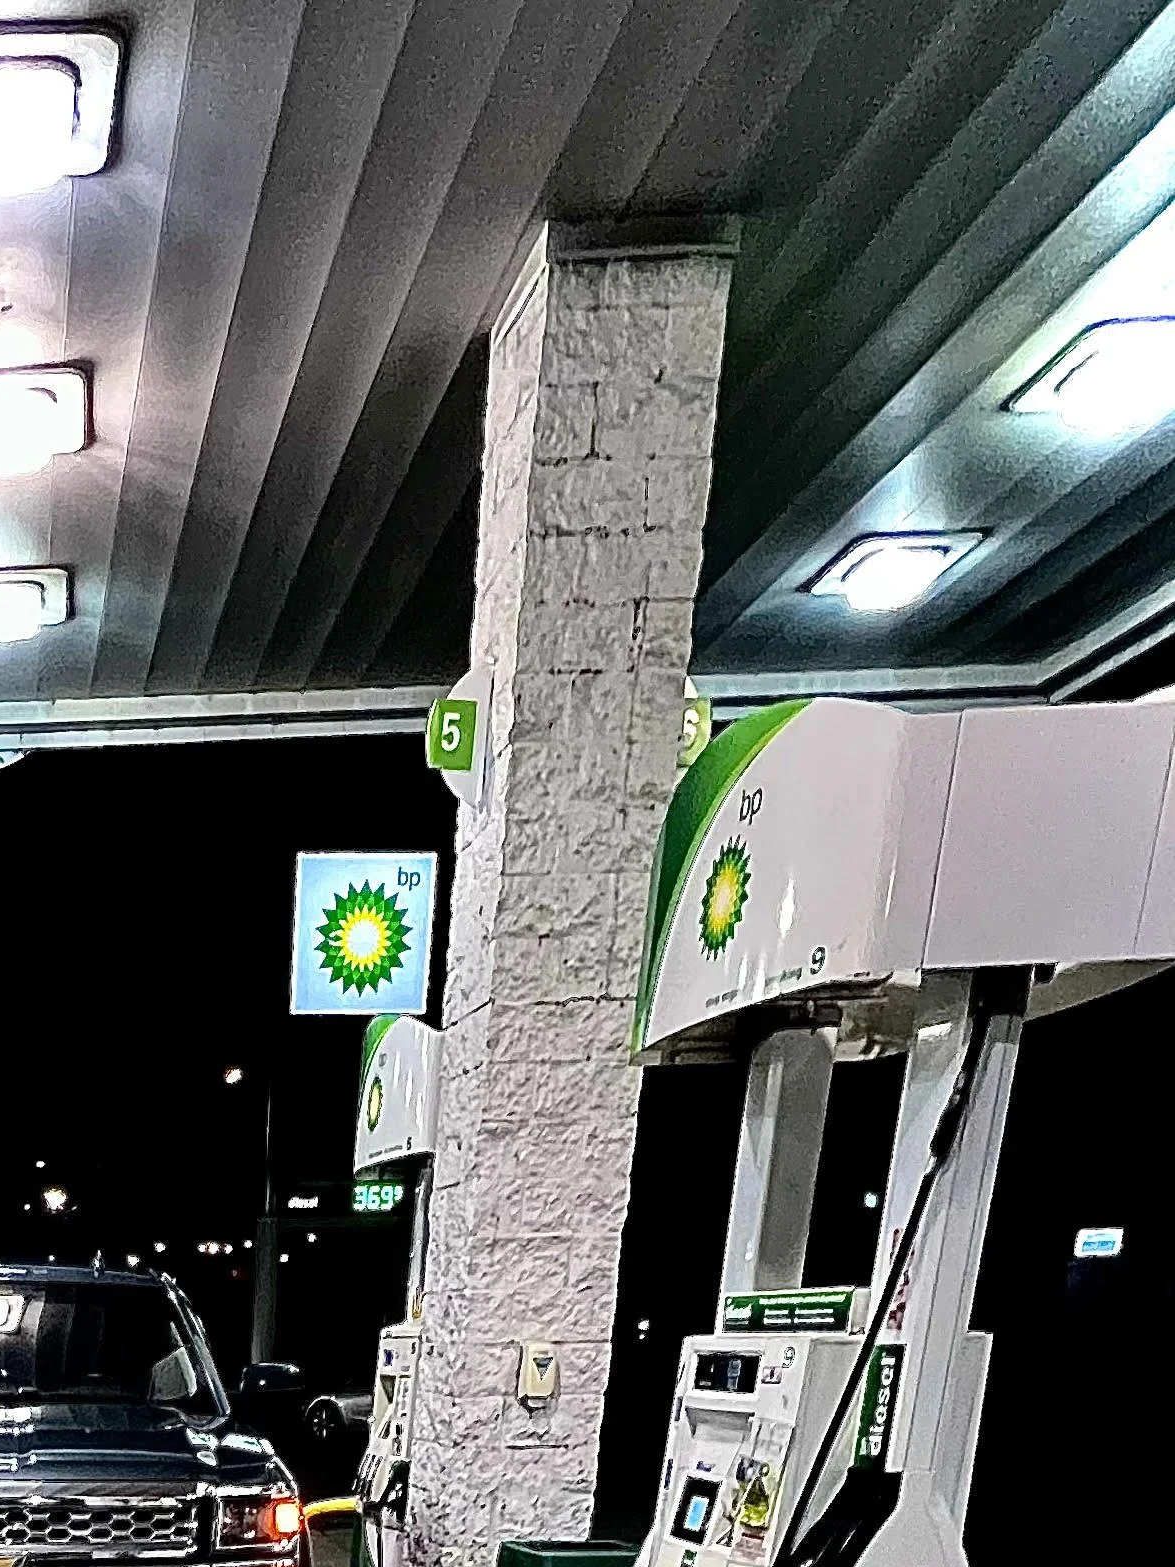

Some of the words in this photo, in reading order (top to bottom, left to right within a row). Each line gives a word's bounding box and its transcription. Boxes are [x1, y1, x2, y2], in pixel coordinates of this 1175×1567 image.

[441, 711, 461, 752] 5
[739, 787, 763, 825] bp
[397, 866, 421, 891] bp
[810, 946, 826, 975] 9
[782, 1346, 796, 1369] 9
[869, 1355, 896, 1457] diesel
